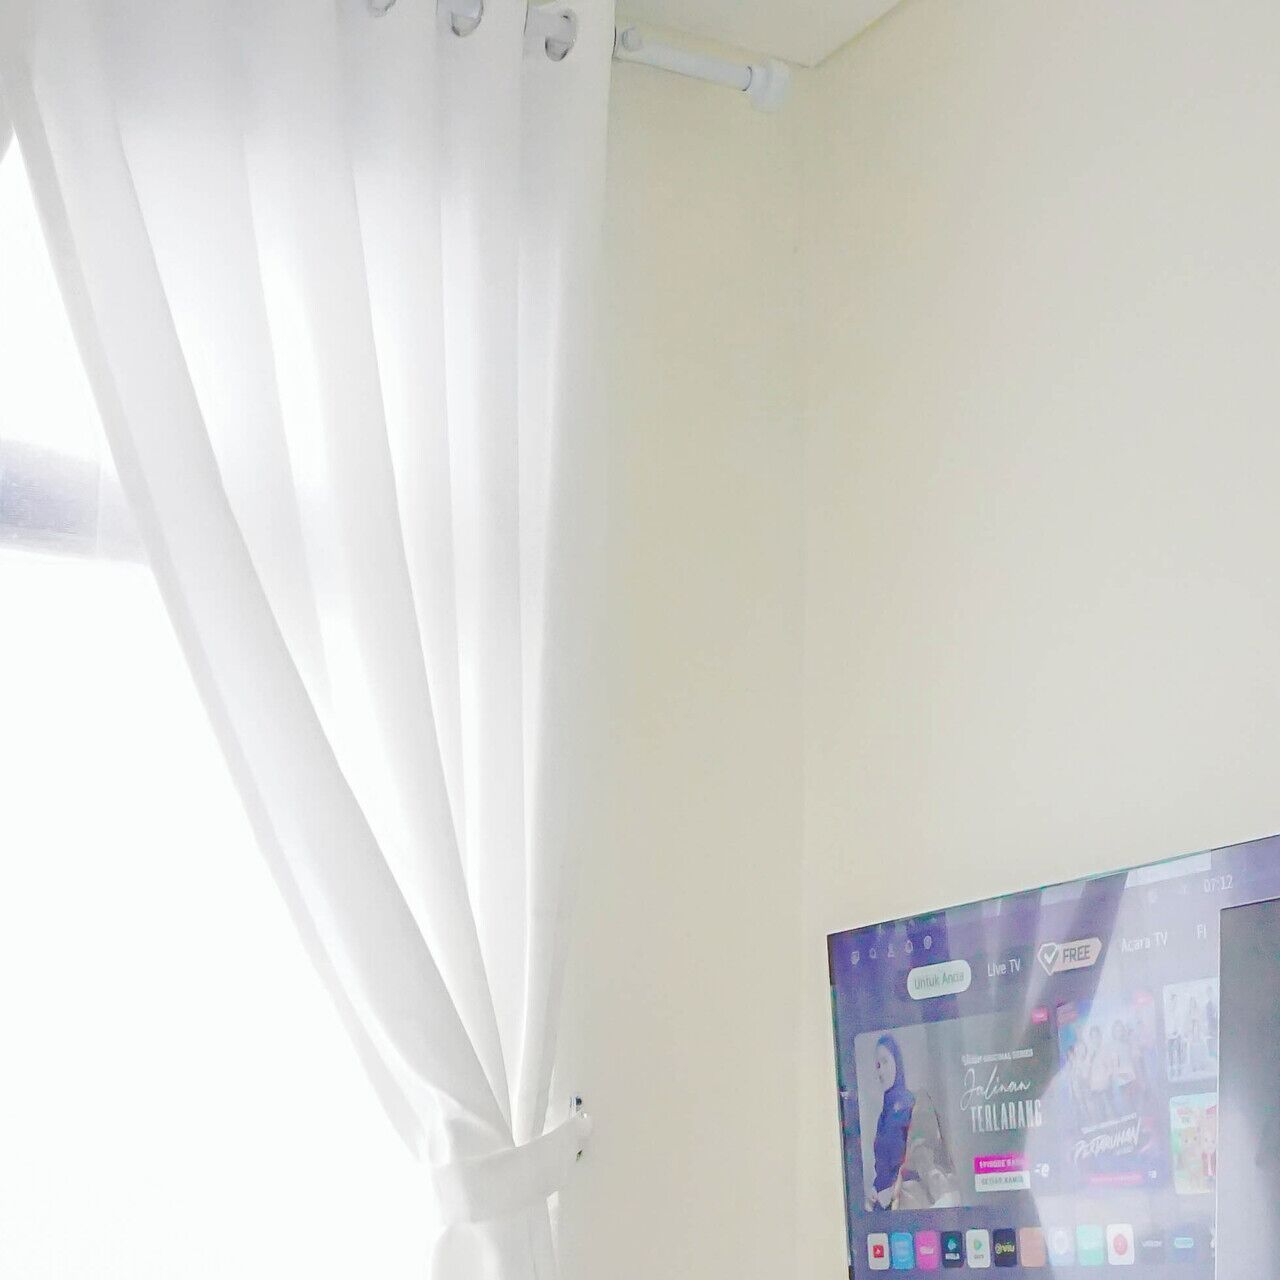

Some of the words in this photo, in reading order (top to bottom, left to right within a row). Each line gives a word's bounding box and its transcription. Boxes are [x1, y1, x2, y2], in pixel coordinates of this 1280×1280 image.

[1062, 944, 1091, 964] FREE
[987, 961, 1007, 977] Live
[1009, 959, 1021, 974] TV
[914, 972, 940, 990] Untuk
[971, 1099, 1042, 1133] TERLARANG
